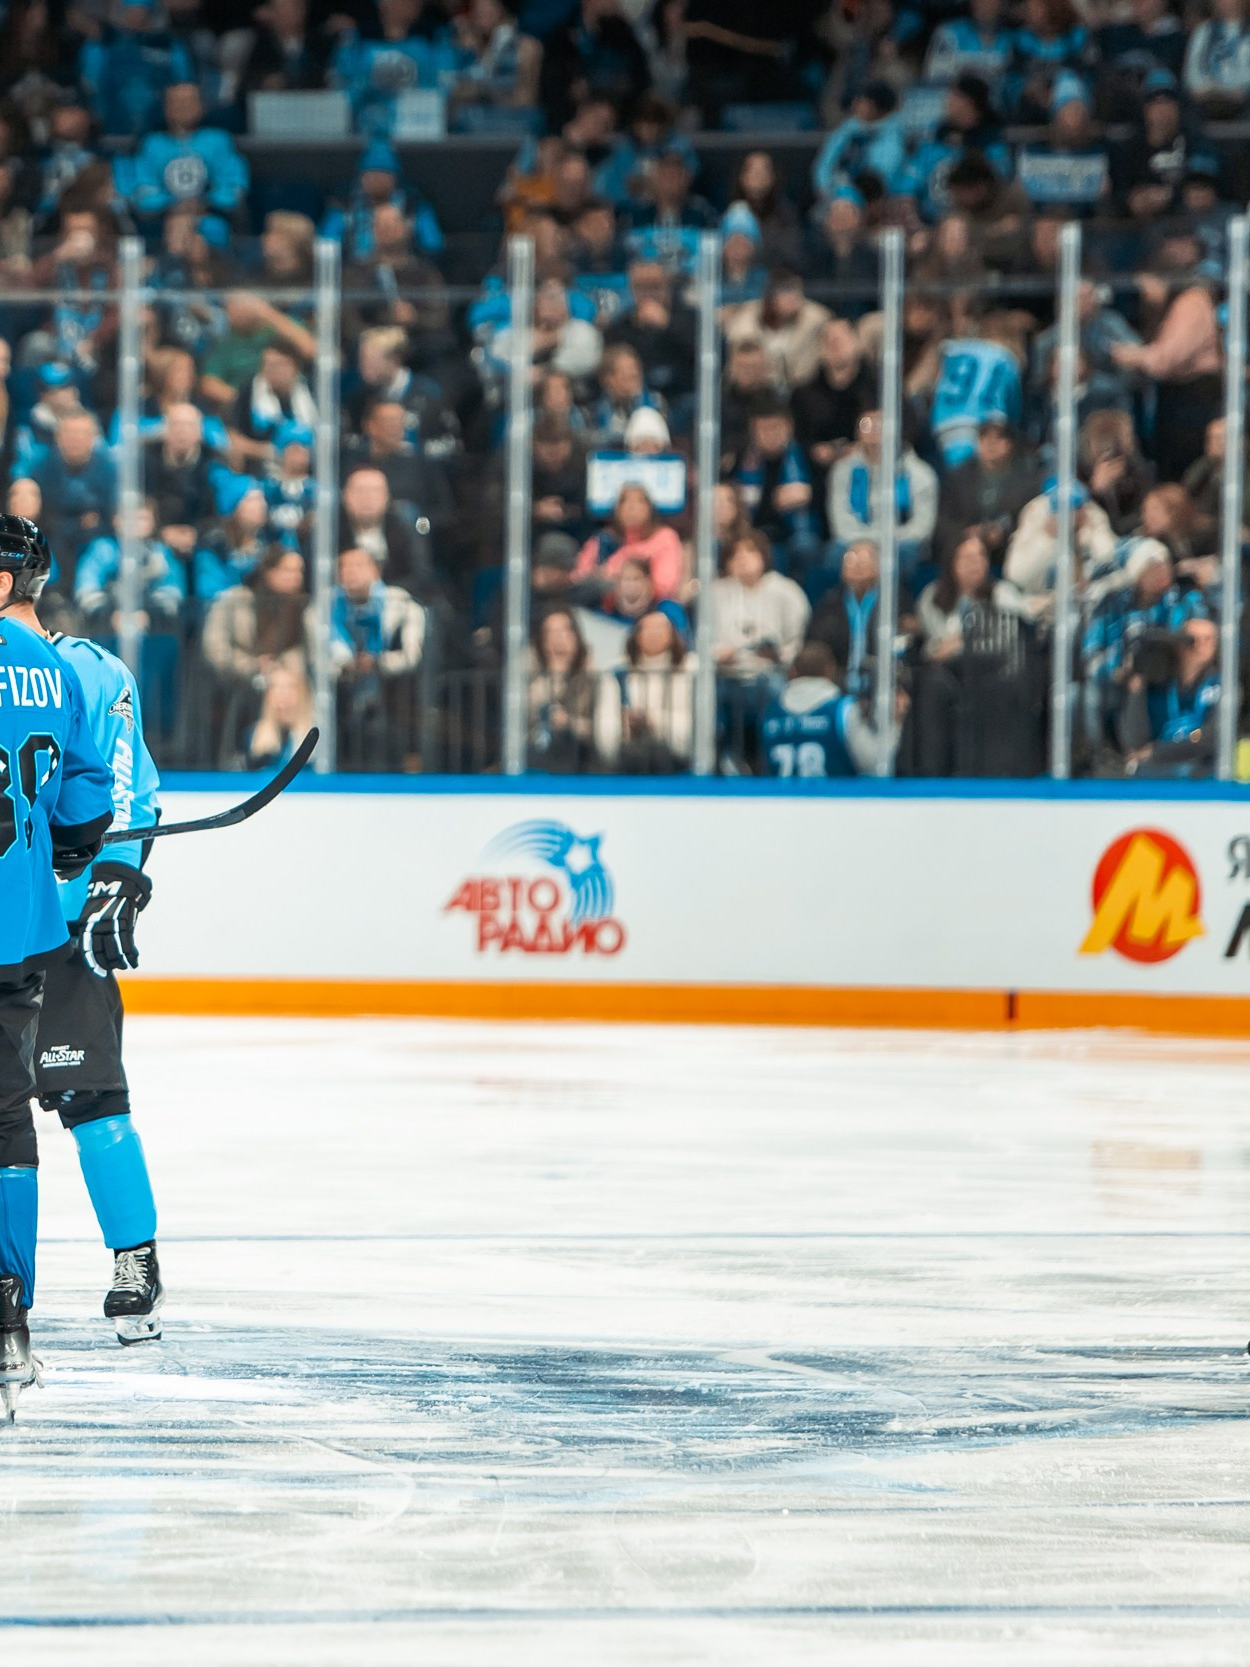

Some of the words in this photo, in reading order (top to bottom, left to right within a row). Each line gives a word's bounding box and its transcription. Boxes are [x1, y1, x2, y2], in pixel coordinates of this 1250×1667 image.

[0, 551, 25, 559] CCM
[444, 877, 560, 913] АВТО
[477, 912, 626, 955] РАДИО
